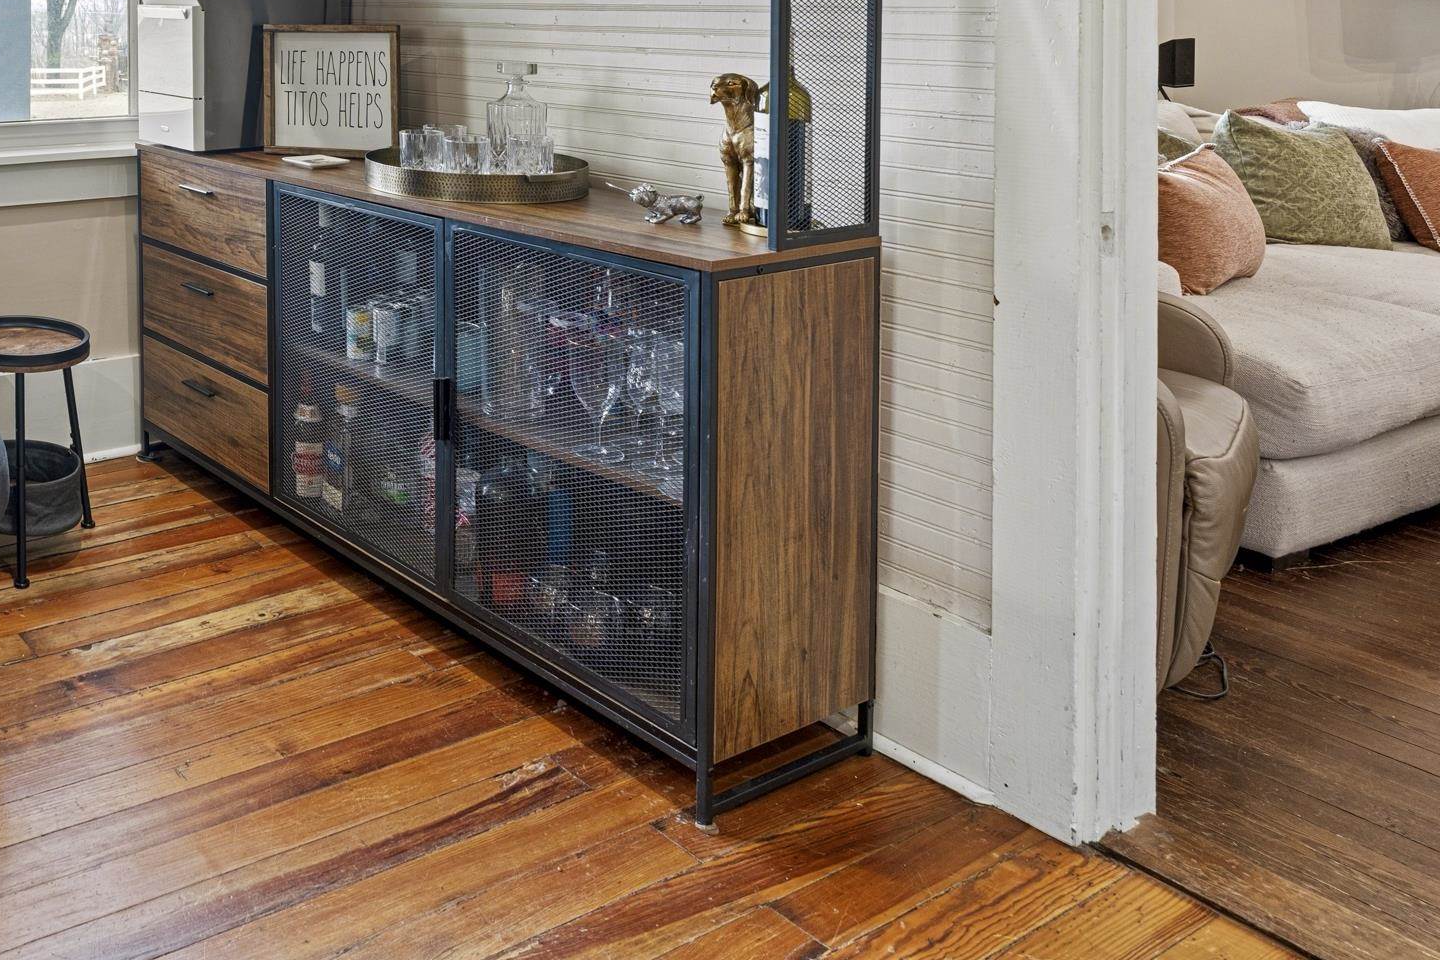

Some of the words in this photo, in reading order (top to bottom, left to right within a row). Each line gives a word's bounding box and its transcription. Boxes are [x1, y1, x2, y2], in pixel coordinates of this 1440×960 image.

[280, 50, 307, 85] LIFE
[316, 50, 388, 87] HAPPENS
[284, 90, 329, 127] TITOS
[338, 92, 384, 129] HELPS
